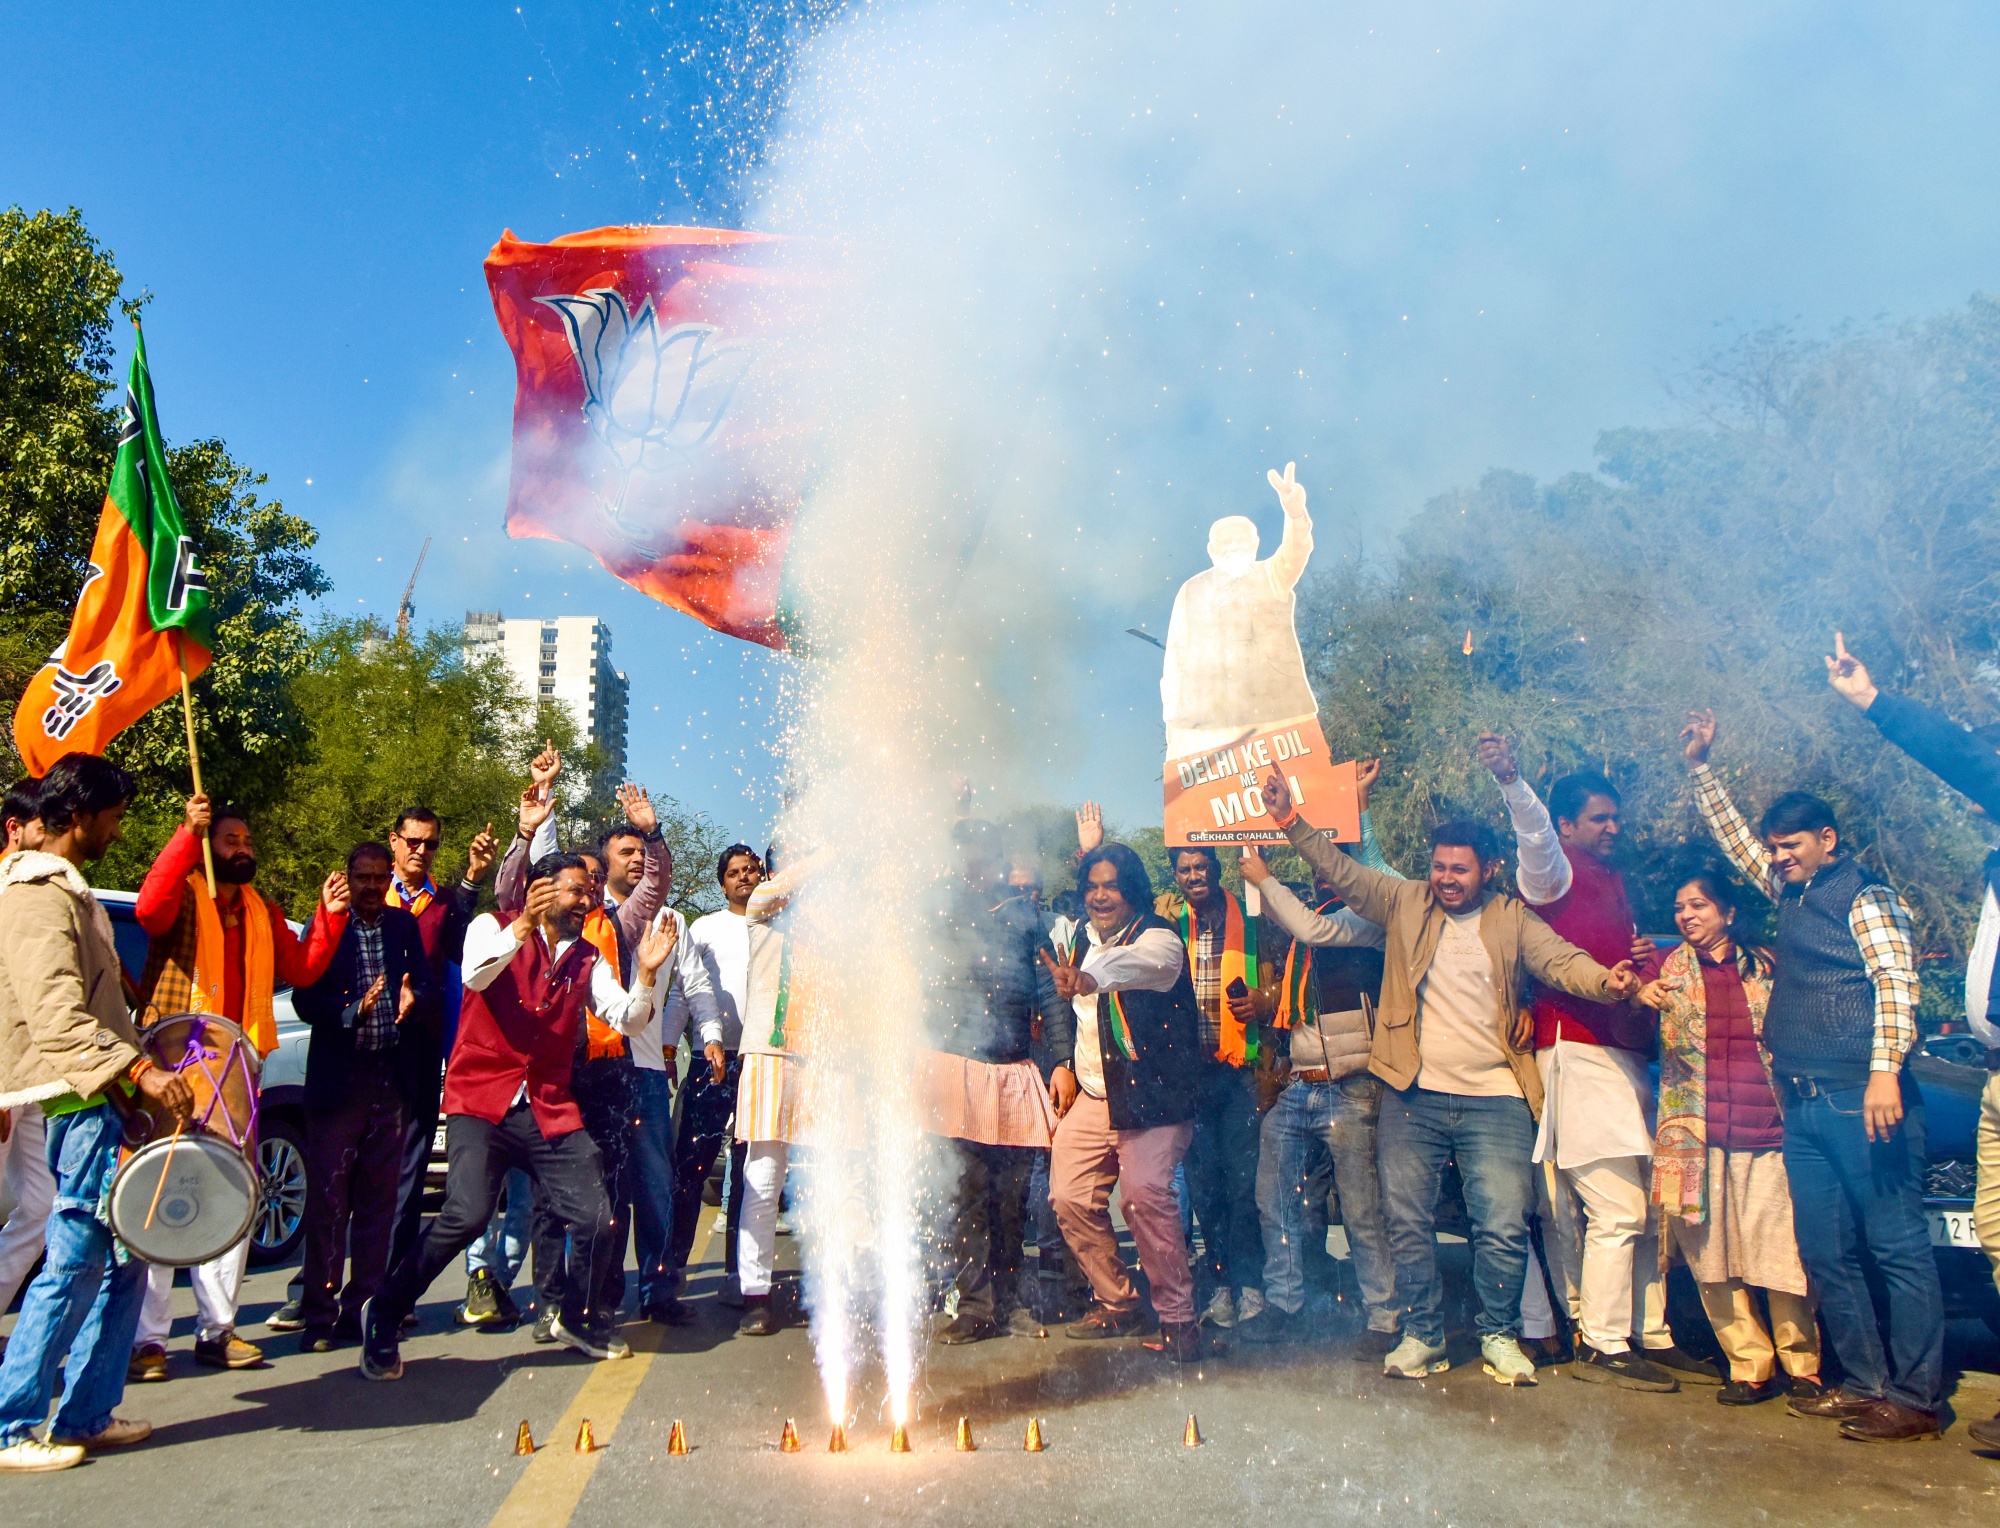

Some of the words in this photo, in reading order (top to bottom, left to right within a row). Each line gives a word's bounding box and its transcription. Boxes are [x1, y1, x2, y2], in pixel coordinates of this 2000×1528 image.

[1177, 749, 1239, 788] DELHI
[1241, 739, 1272, 770] KE
[1272, 730, 1312, 761] DIL
[1239, 770, 1258, 788] ME
[1209, 775, 1305, 828] MOI
[1190, 833, 1235, 842] SHEKHAR
[1236, 832, 1274, 841] CHAHAL
